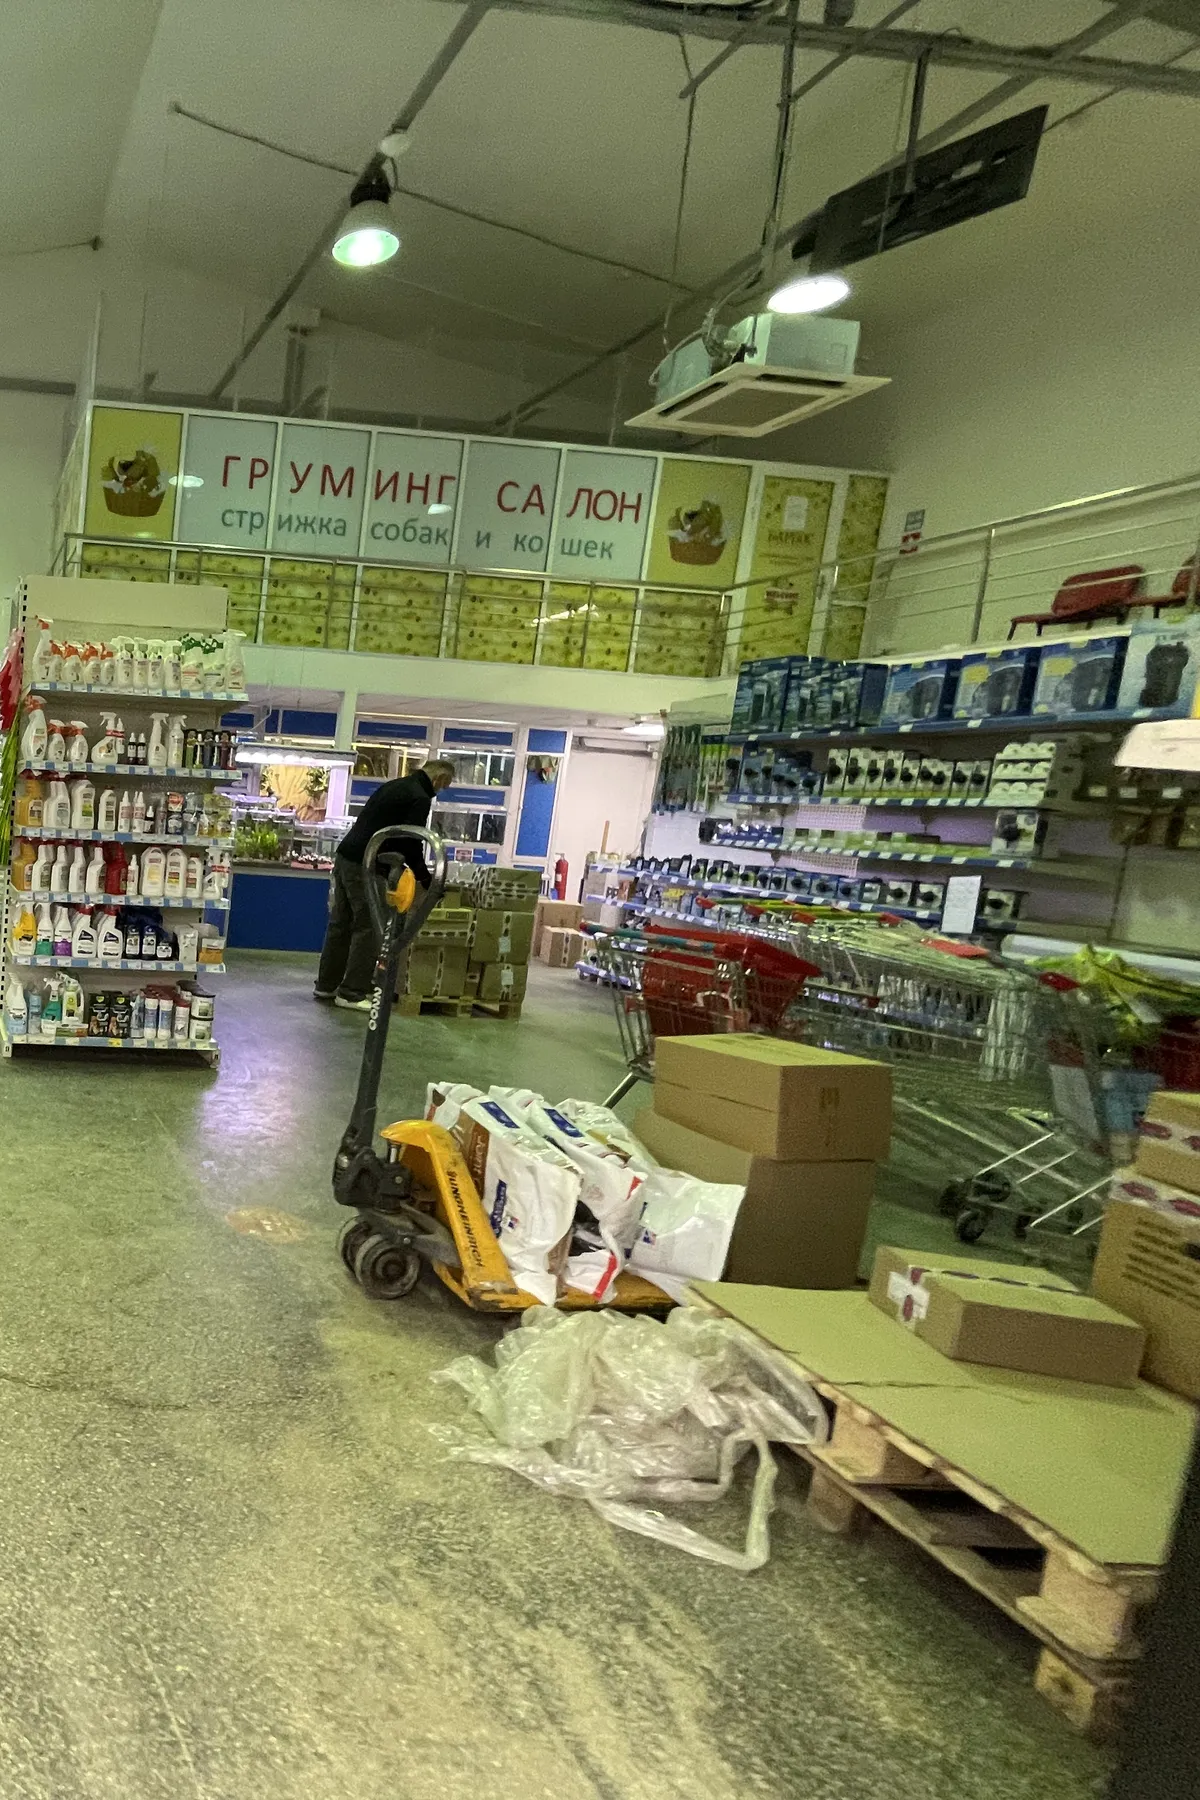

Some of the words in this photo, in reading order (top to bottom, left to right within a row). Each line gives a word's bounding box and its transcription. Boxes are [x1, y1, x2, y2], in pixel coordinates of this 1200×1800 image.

[221, 455, 457, 505] ГРУМИНГ
[496, 480, 643, 524] САЛОН
[220, 507, 348, 537] стрижка
[370, 516, 450, 546] собак
[475, 530, 492, 549] и
[513, 532, 616, 560] кошек
[368, 986, 383, 1031] 2200
